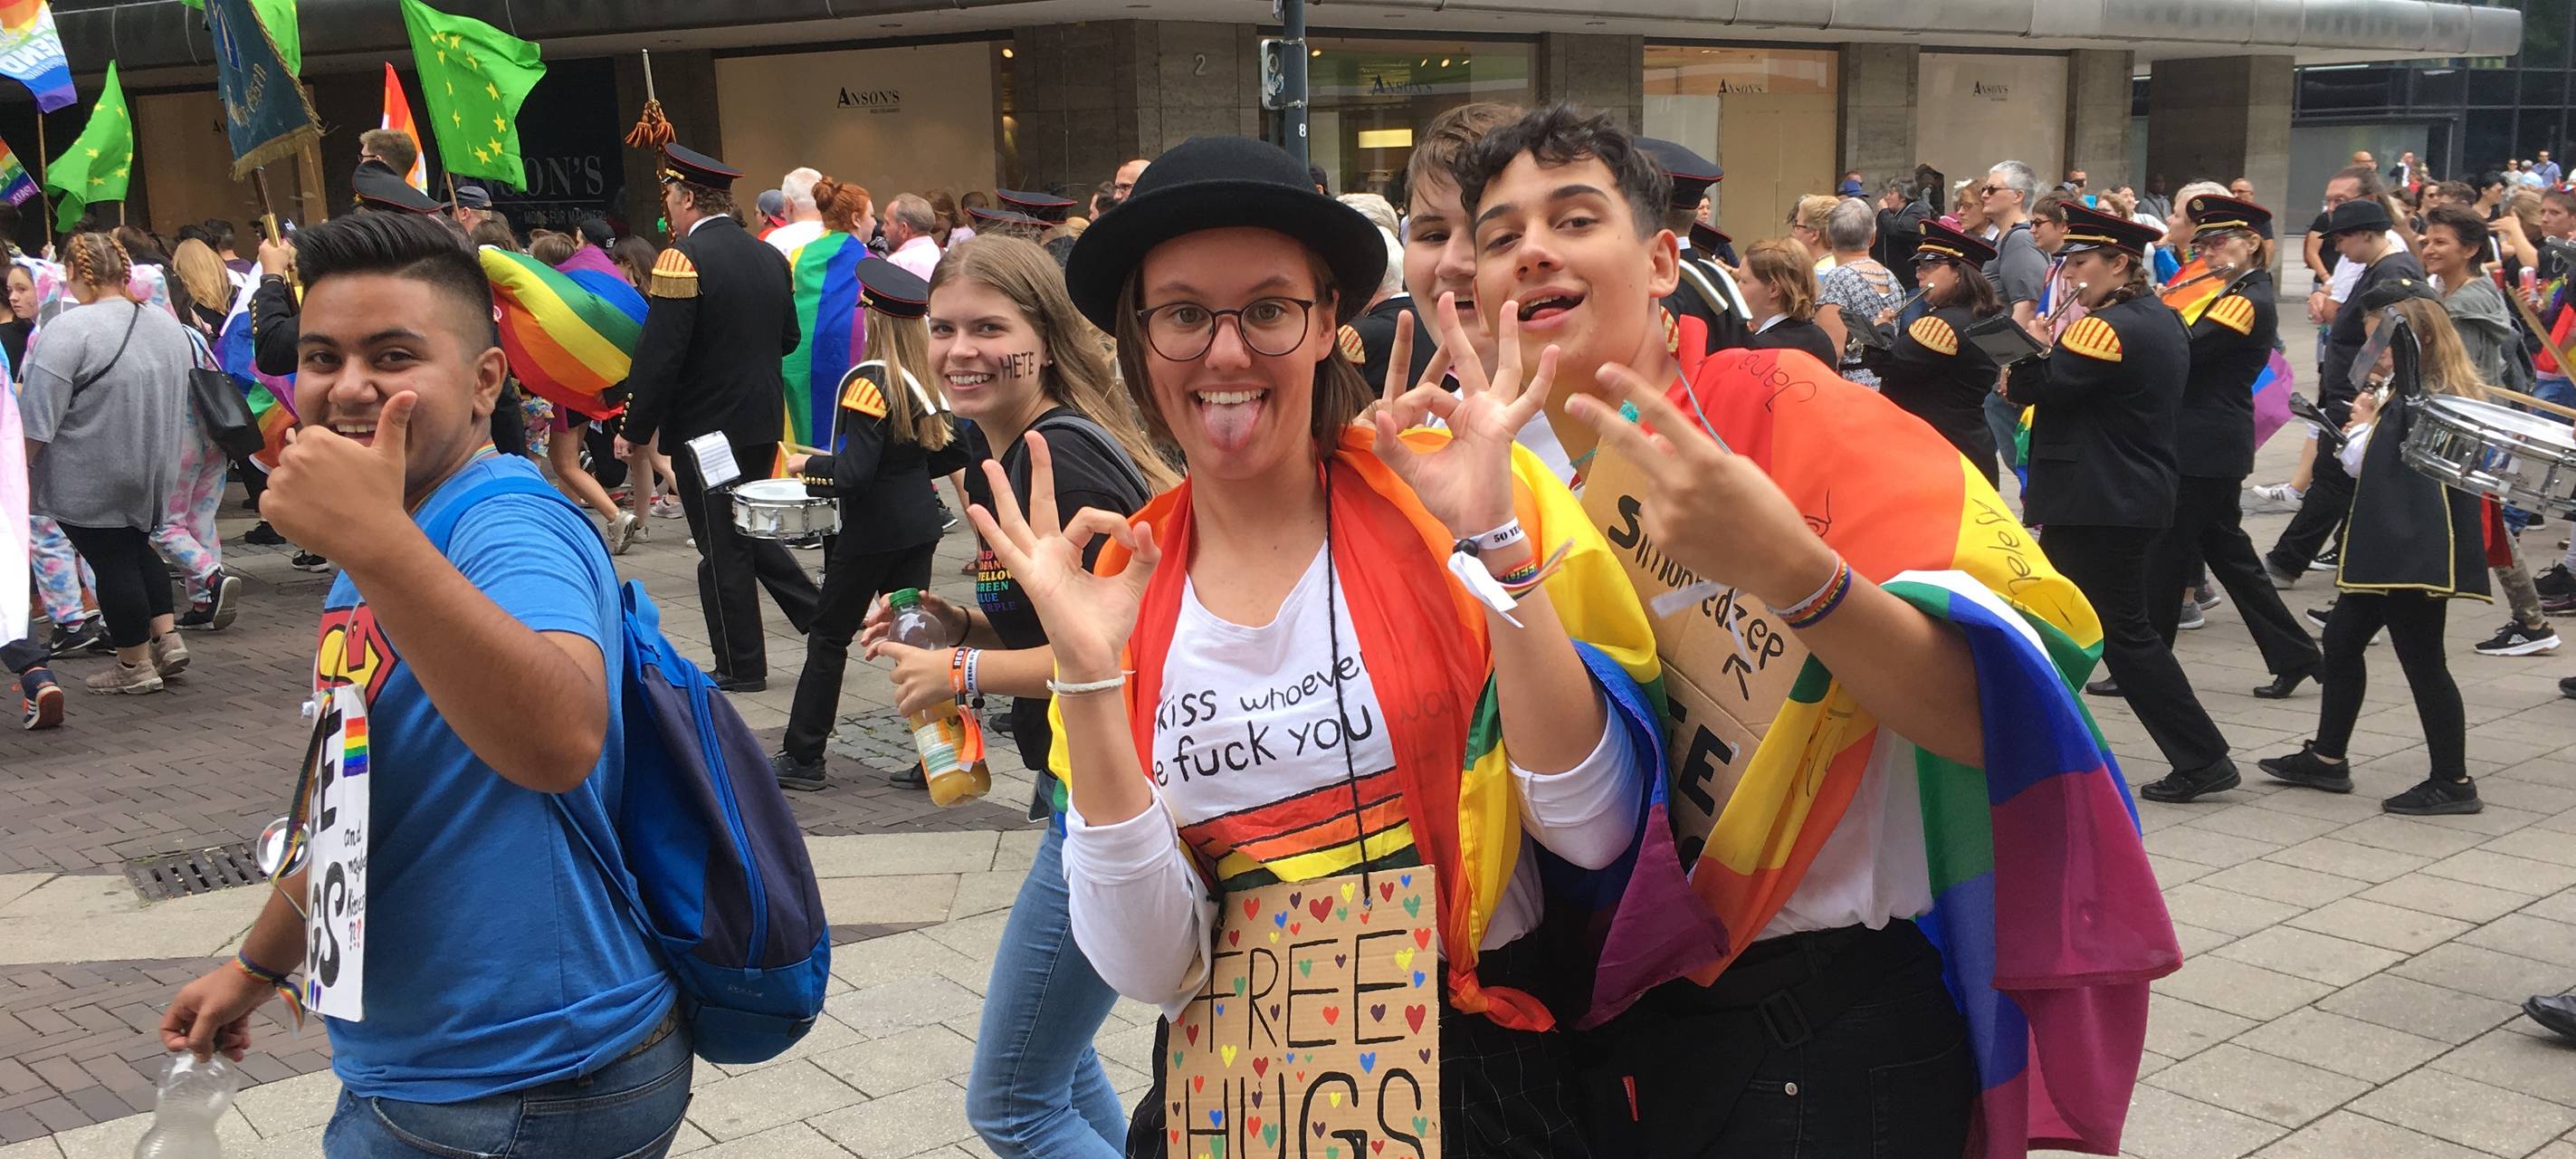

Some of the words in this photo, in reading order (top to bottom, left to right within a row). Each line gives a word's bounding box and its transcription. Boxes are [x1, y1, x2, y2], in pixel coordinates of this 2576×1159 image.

[1195, 53, 1207, 76] 2
[837, 86, 900, 109] ANSON'S
[1299, 122, 1307, 138] 8
[1493, 532, 1508, 543] 50
[1509, 525, 1521, 537] YE
[1173, 721, 1276, 782] fuck
[1288, 704, 1373, 757] you
[344, 819, 362, 848] and
[1192, 929, 1407, 1053] FREE
[1186, 1068, 1426, 1159] HUGS
